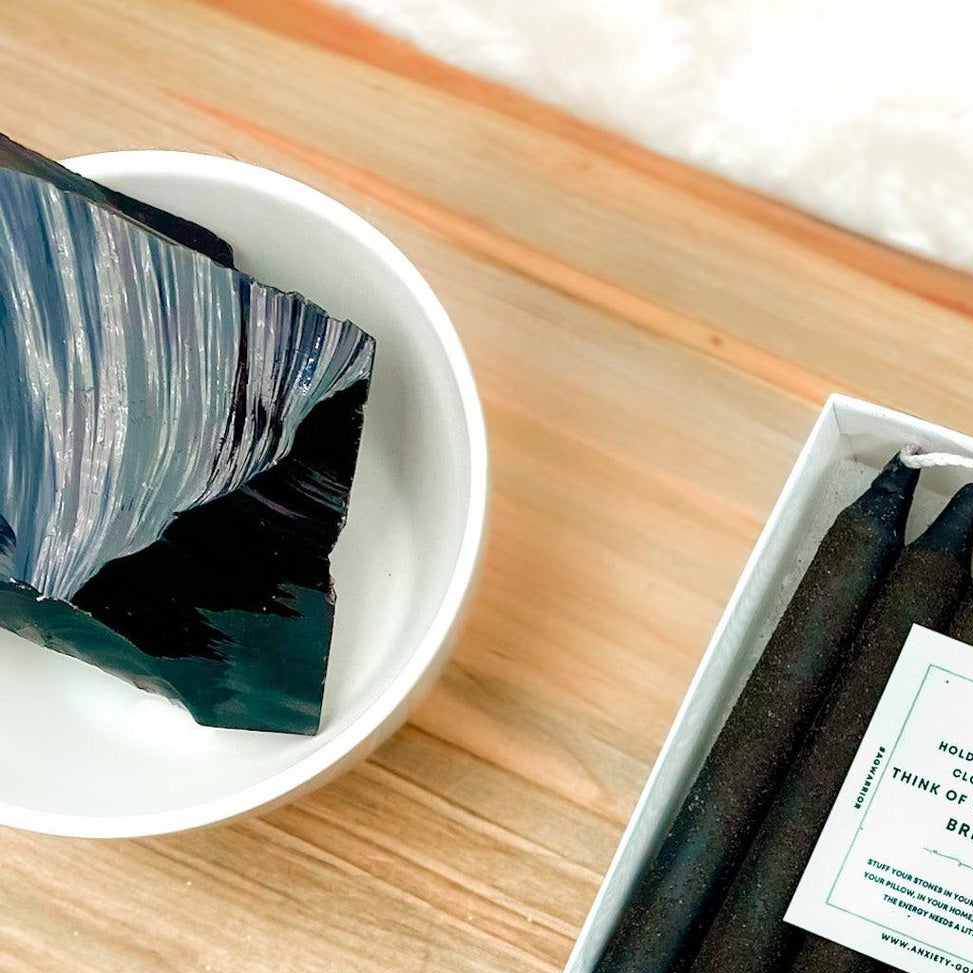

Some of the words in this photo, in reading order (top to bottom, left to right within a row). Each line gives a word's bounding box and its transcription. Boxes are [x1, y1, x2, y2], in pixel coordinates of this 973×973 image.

[892, 766, 941, 796] THINK
[945, 789, 968, 805] OF
[864, 871, 885, 885] YOUR
[885, 880, 916, 899] PILLOW,
[916, 893, 927, 902] IN
[927, 896, 949, 912] YOUR
[948, 906, 973, 923] HOME,
[867, 858, 891, 872] STUFF
[891, 868, 913, 882] YOUR
[913, 876, 944, 894] STONES
[943, 889, 953, 898] IN
[883, 893, 899, 906] THE
[897, 900, 929, 917] ENERGY
[928, 912, 954, 928] NEEDS
[953, 923, 960, 931] A
